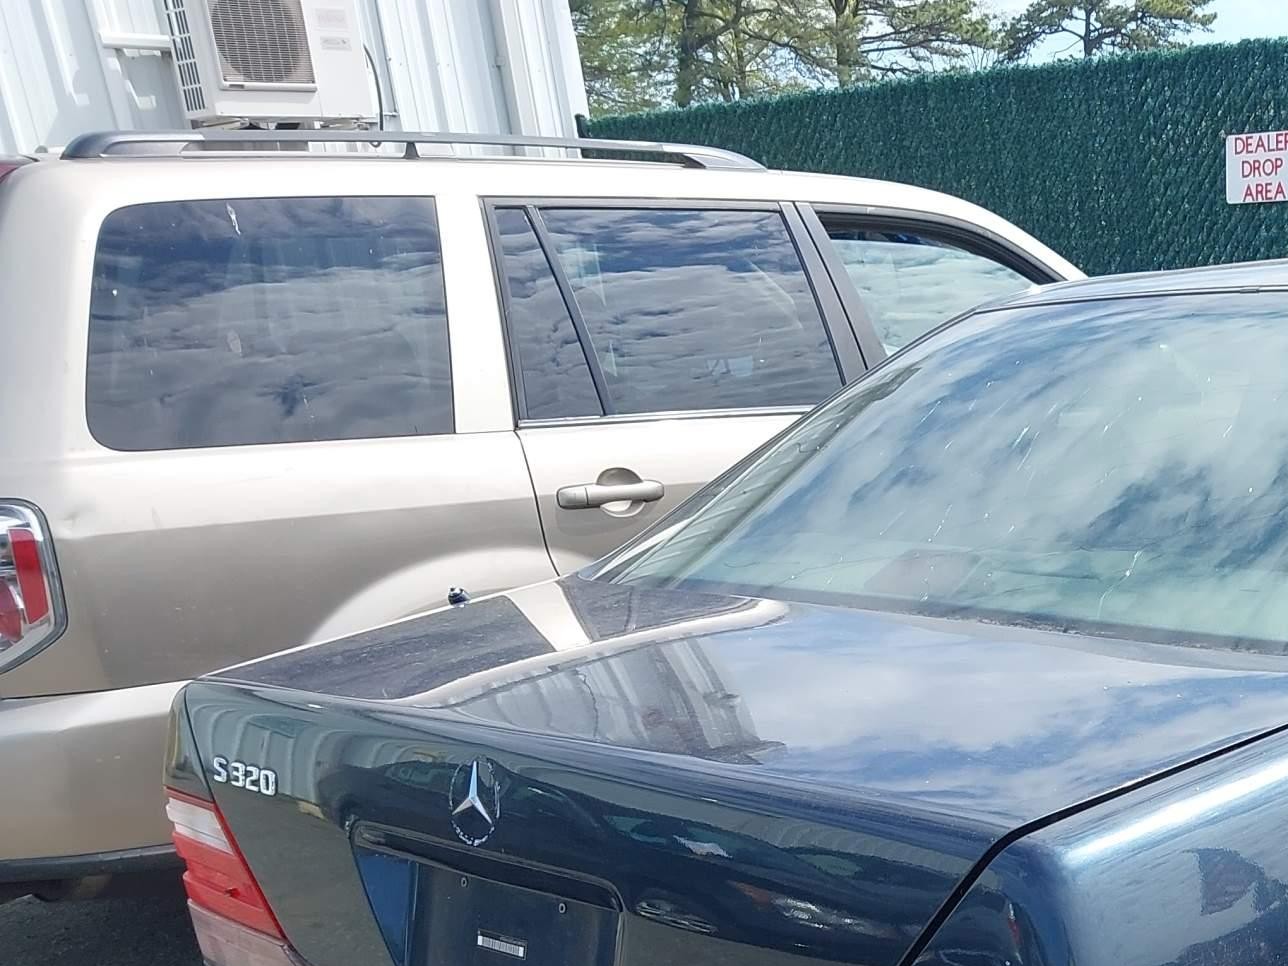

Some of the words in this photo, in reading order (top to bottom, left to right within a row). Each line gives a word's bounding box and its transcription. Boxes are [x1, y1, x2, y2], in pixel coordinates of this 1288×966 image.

[1241, 157, 1284, 178] DROP
[1242, 181, 1286, 202] AREA
[213, 756, 228, 783] S
[230, 761, 276, 797] 320
